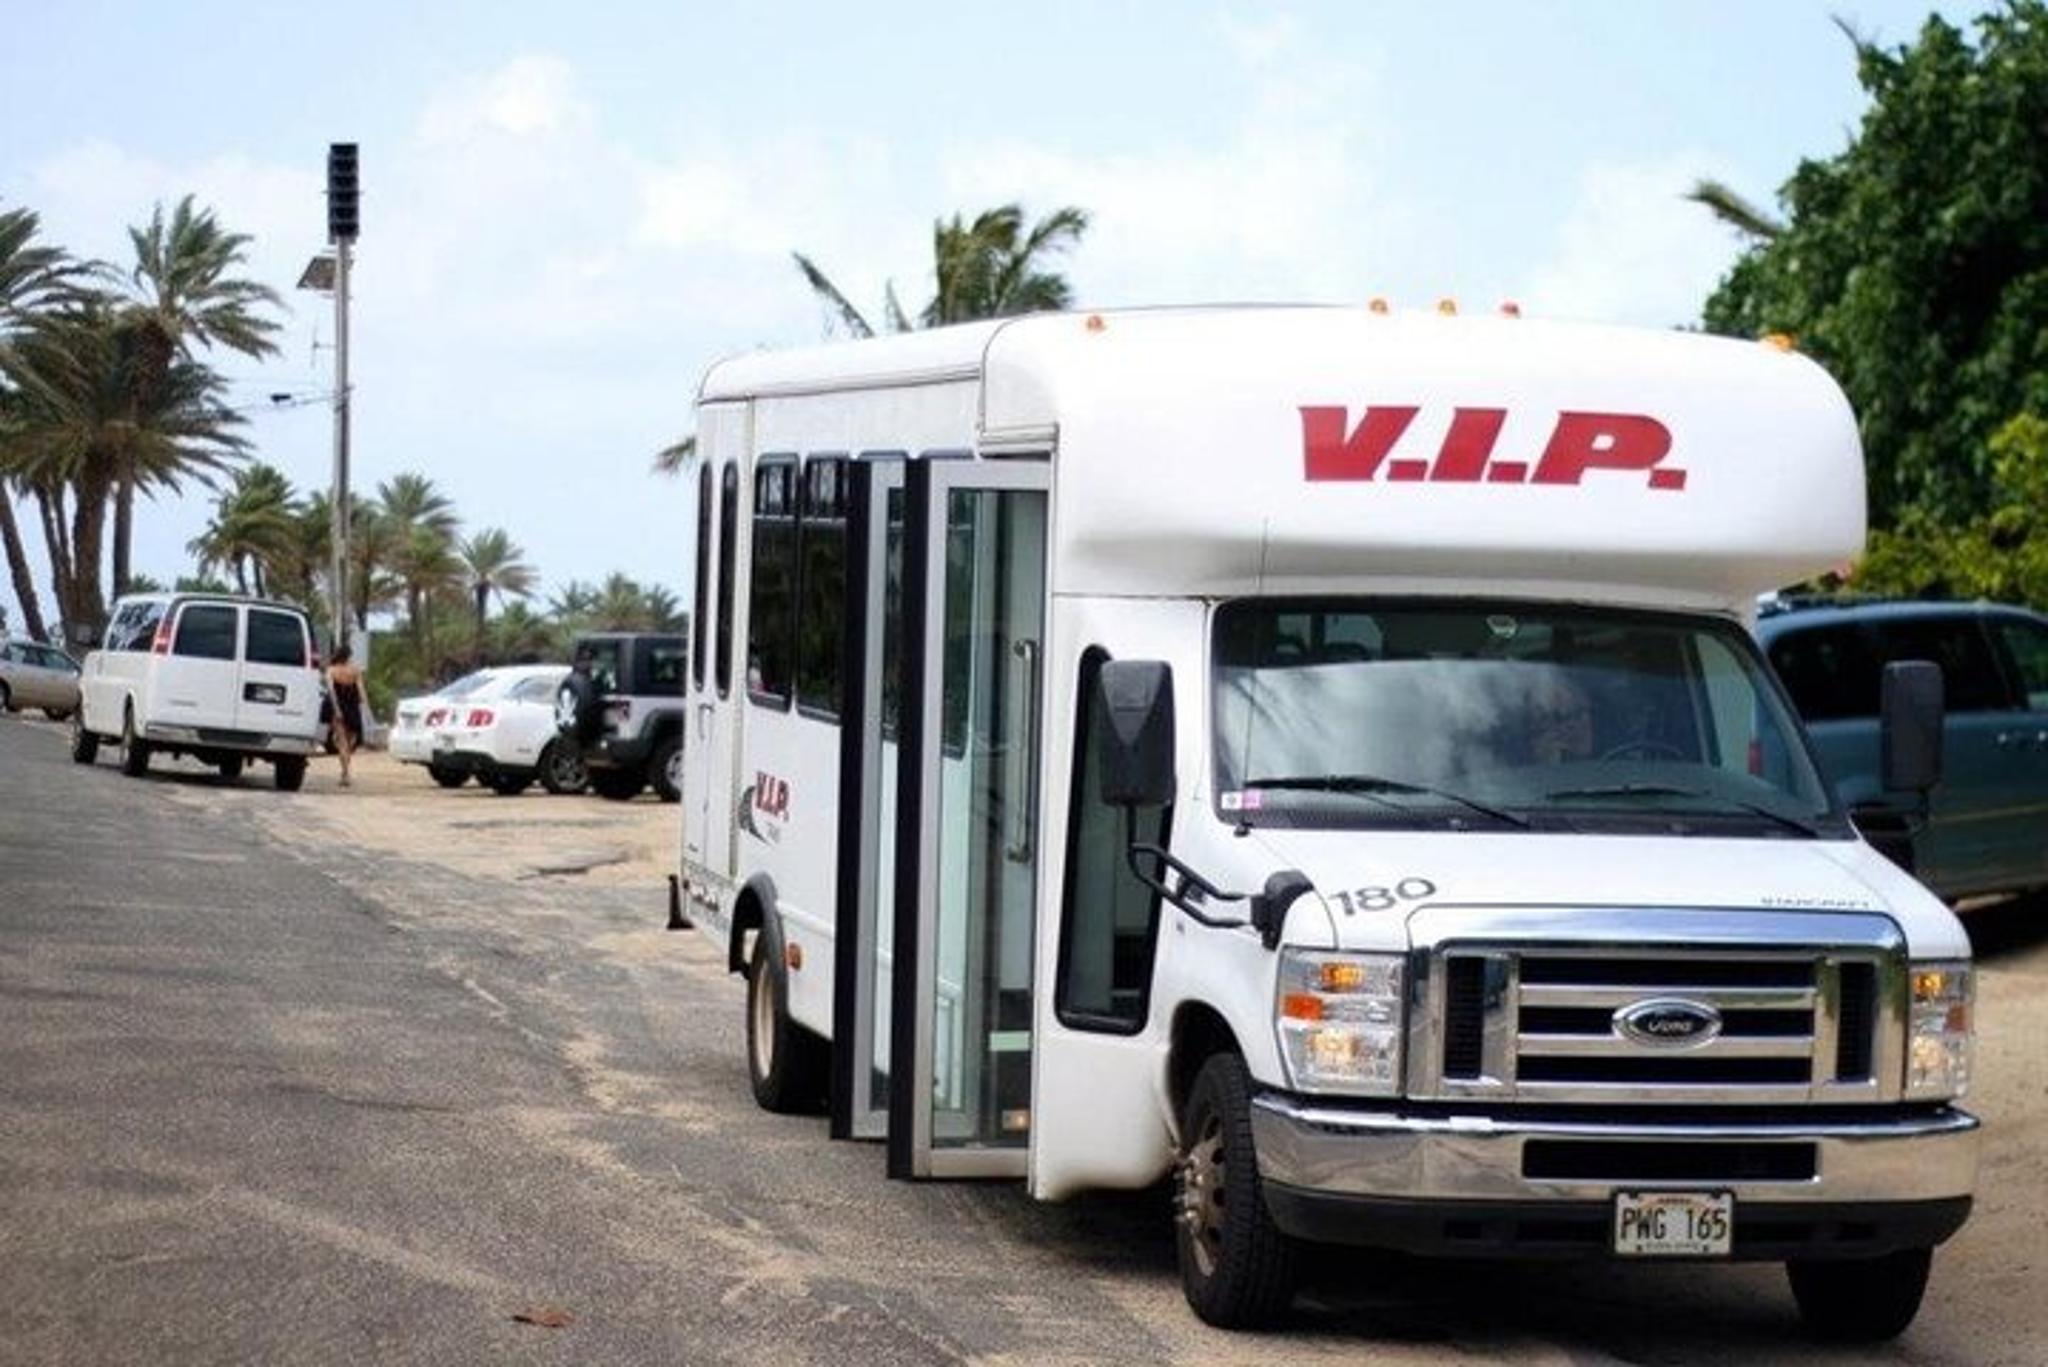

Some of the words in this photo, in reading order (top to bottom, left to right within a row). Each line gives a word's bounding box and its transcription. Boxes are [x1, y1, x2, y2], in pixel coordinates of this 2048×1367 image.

[1298, 405, 1687, 490] V.I.P.
[1328, 877, 1436, 916] 180
[1686, 1207, 1727, 1240] 165
